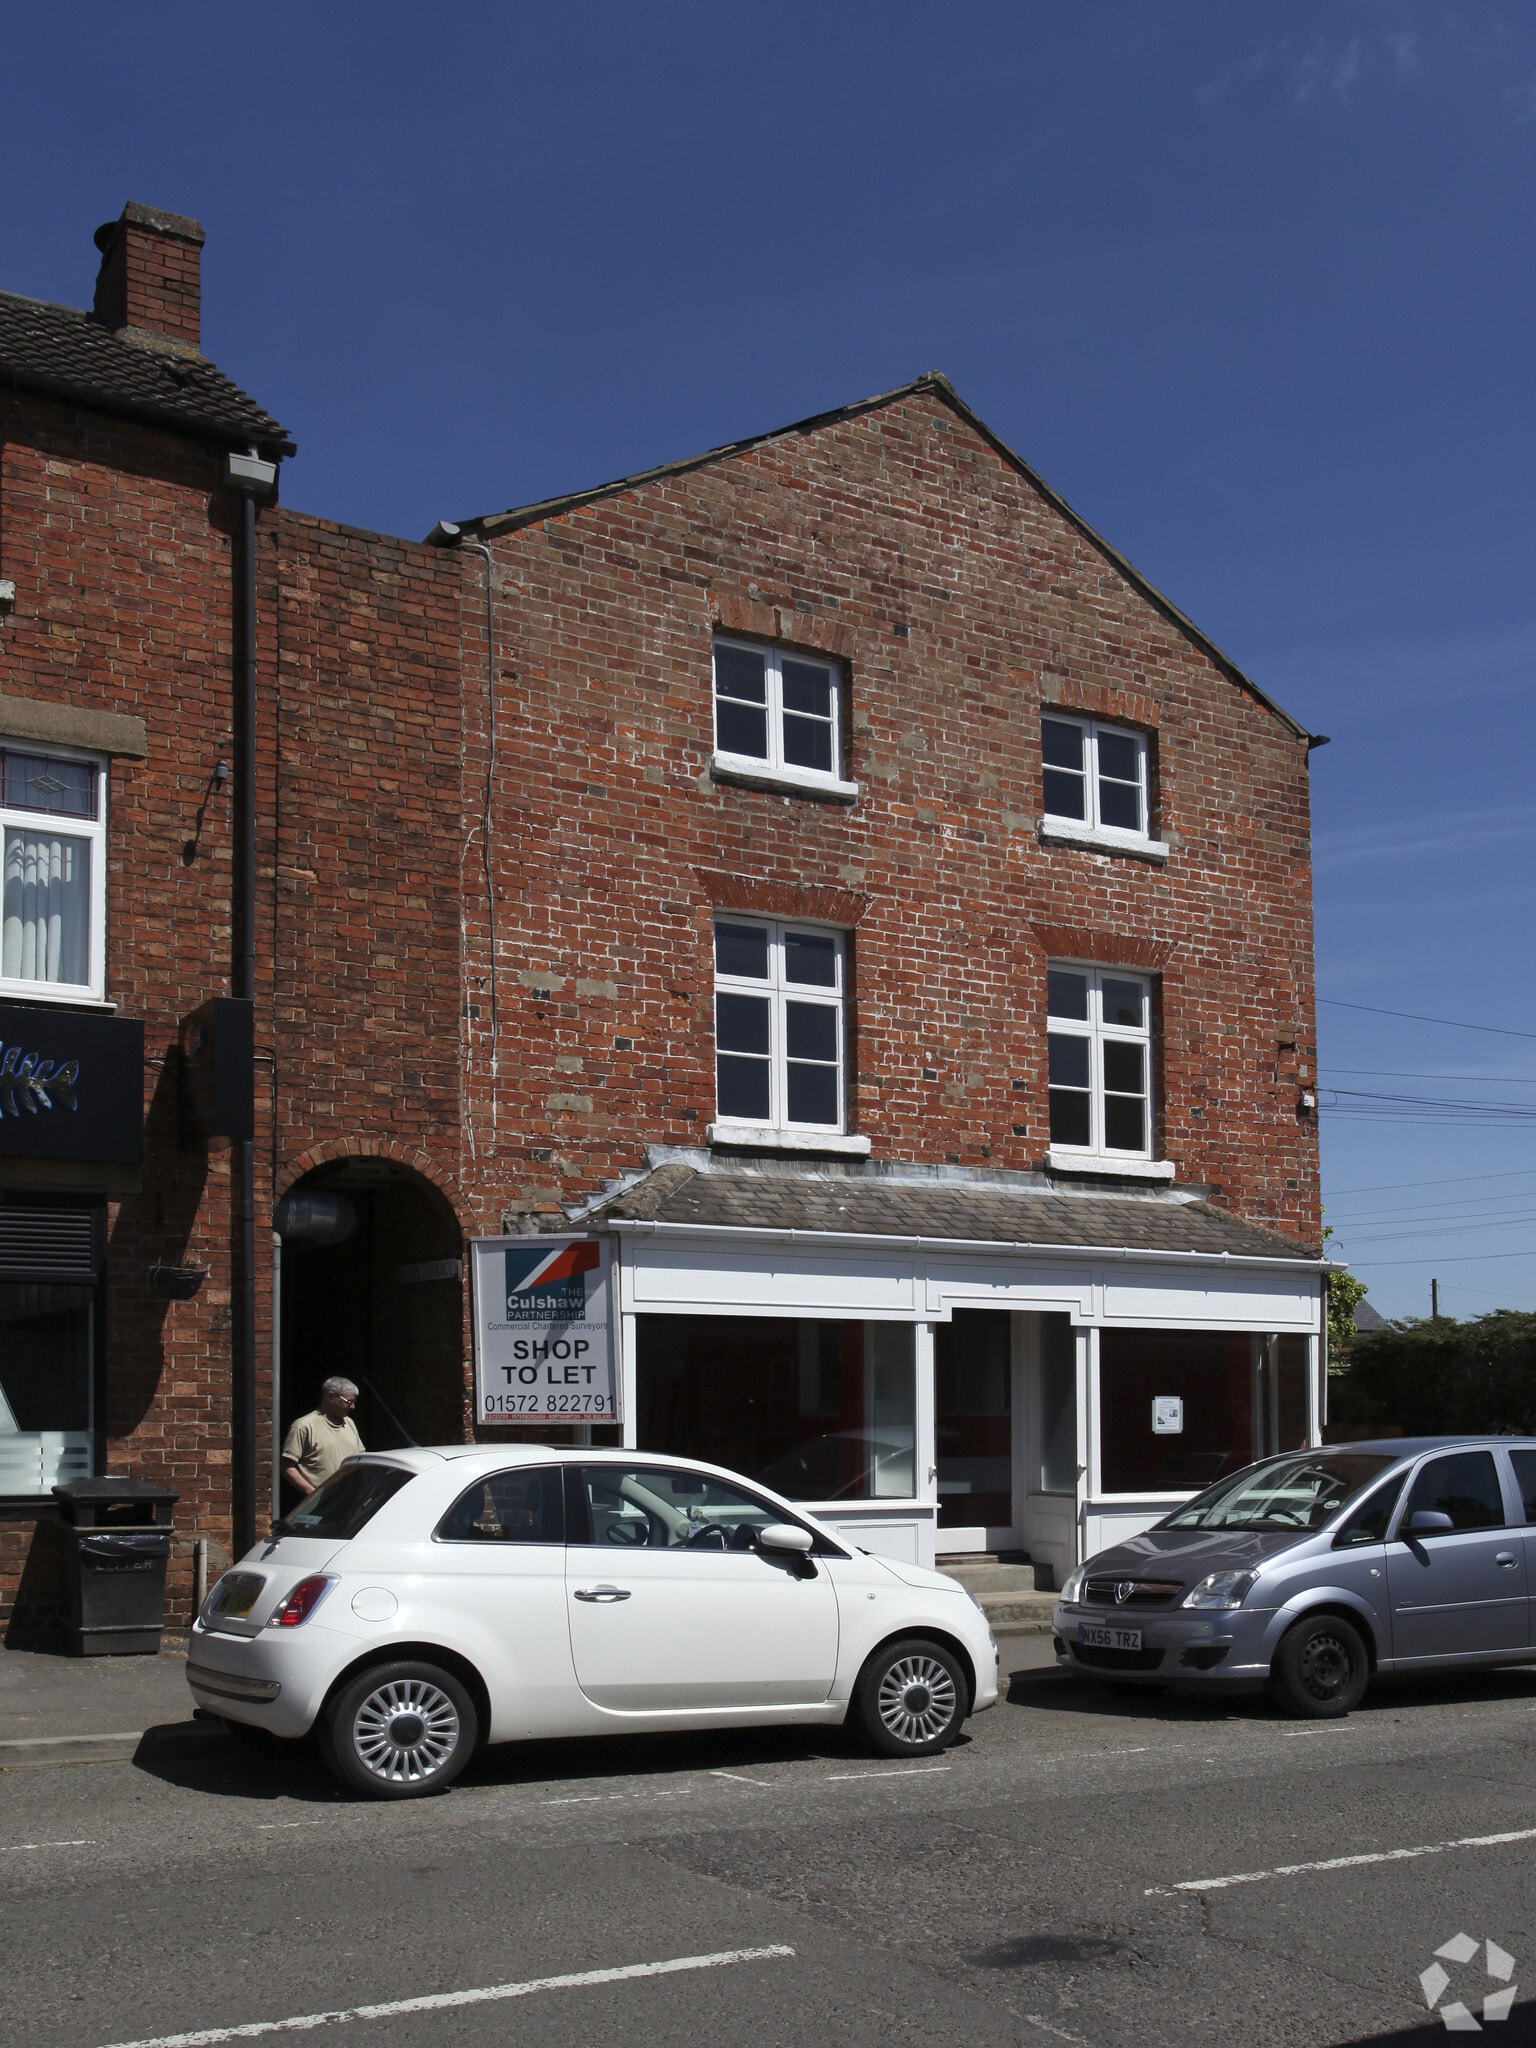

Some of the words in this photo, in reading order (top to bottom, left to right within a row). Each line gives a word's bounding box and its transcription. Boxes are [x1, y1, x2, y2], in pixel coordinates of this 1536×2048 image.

[561, 1287, 584, 1297] THE
[507, 1295, 584, 1309] Culshaw
[507, 1310, 585, 1320] PARTNERSHIP
[487, 1322, 530, 1331] Commercial
[532, 1322, 568, 1330] Chartered
[571, 1321, 608, 1332] Surveyors
[513, 1339, 590, 1360] SHOP
[501, 1366, 538, 1384] TO
[547, 1366, 597, 1384] LET
[485, 1394, 538, 1412] 01572
[546, 1394, 614, 1412] 822791
[1083, 1629, 1111, 1645] NX56
[1115, 1631, 1139, 1648] TRZ
